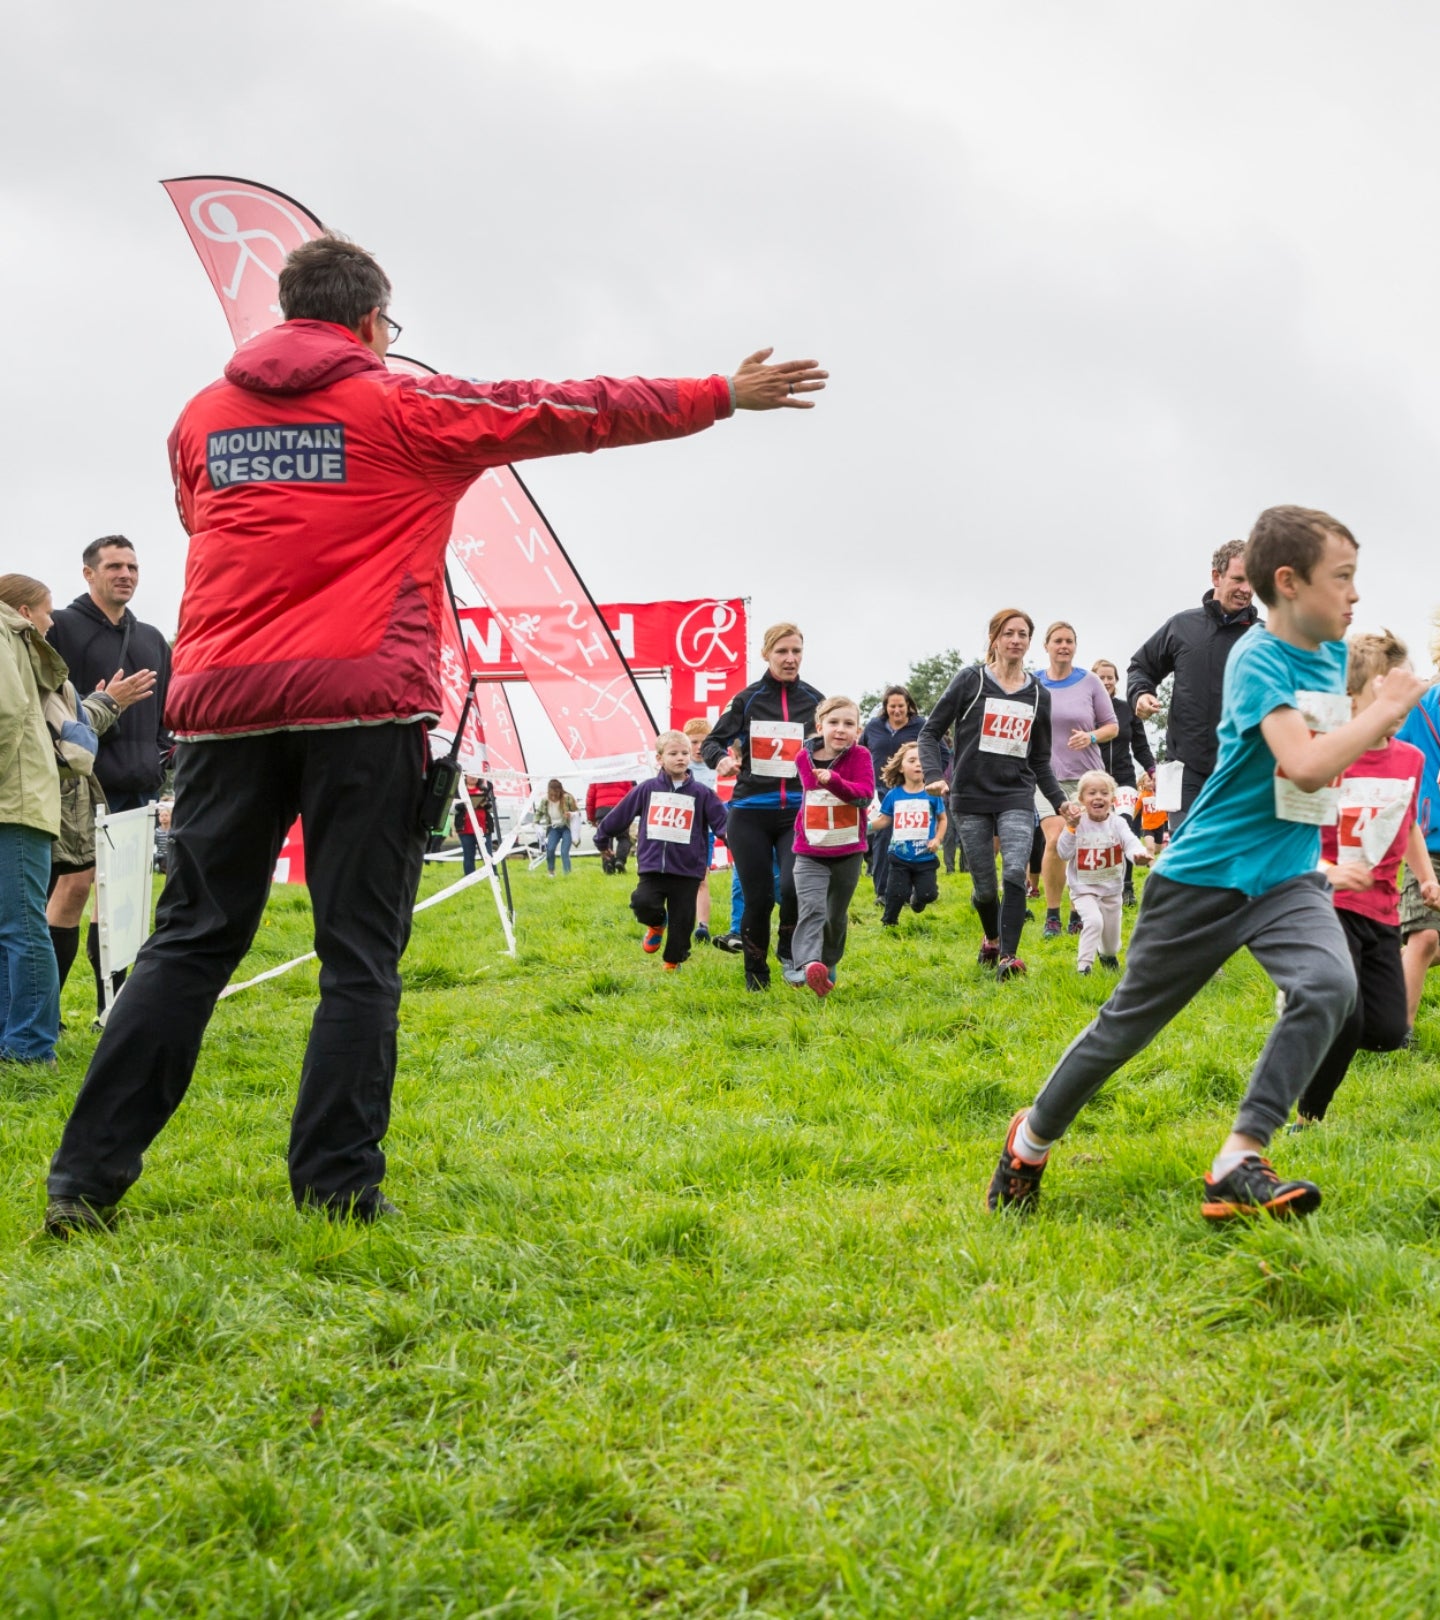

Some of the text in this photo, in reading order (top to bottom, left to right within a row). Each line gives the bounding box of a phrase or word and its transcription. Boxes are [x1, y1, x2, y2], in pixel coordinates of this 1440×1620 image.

[210, 429, 341, 457] MOUNTAIN
[210, 454, 342, 486] RESCUE
[989, 715, 1026, 739] 448
[770, 738, 784, 761] 2
[653, 806, 687, 829] 446
[898, 813, 925, 829] 459
[1084, 845, 1115, 870] 451
